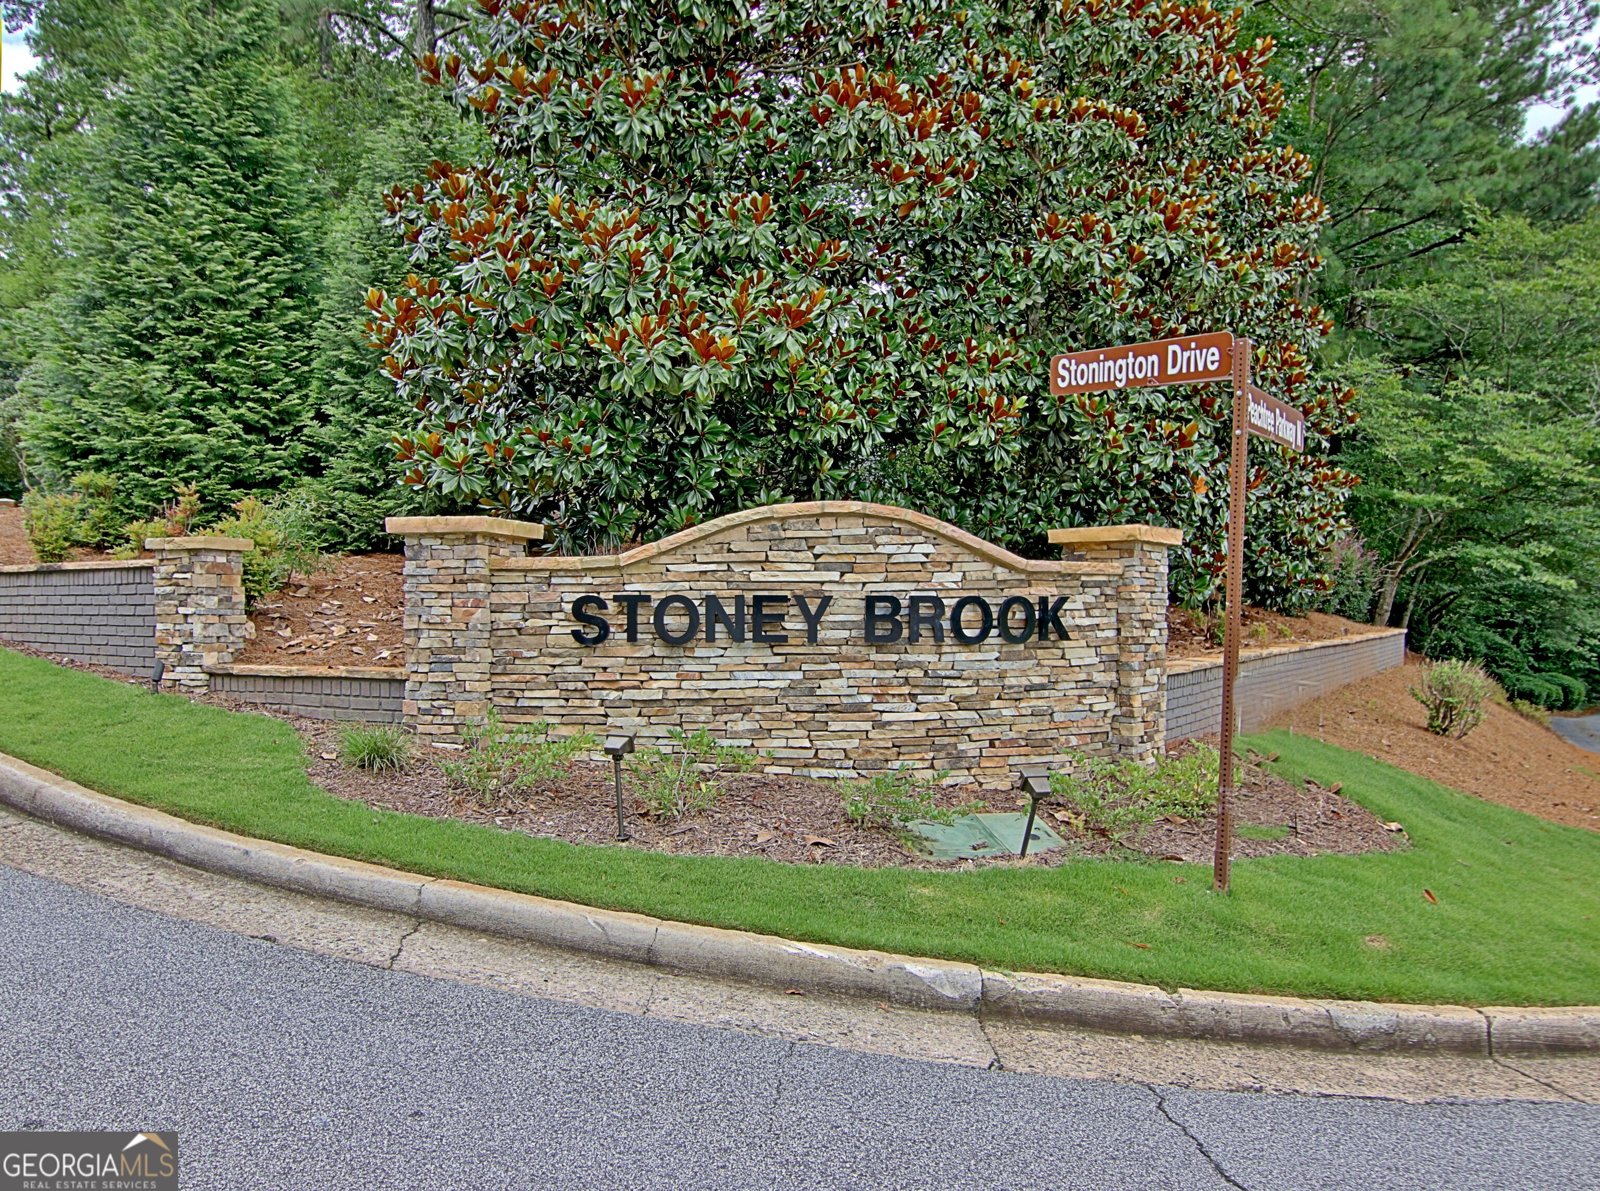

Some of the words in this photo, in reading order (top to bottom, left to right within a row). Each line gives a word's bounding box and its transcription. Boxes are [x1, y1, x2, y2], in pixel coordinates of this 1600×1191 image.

[1057, 353, 1159, 388] Stonington
[1167, 341, 1220, 375] Drive
[570, 594, 834, 646] STONEY
[864, 594, 1072, 644] BROOK
